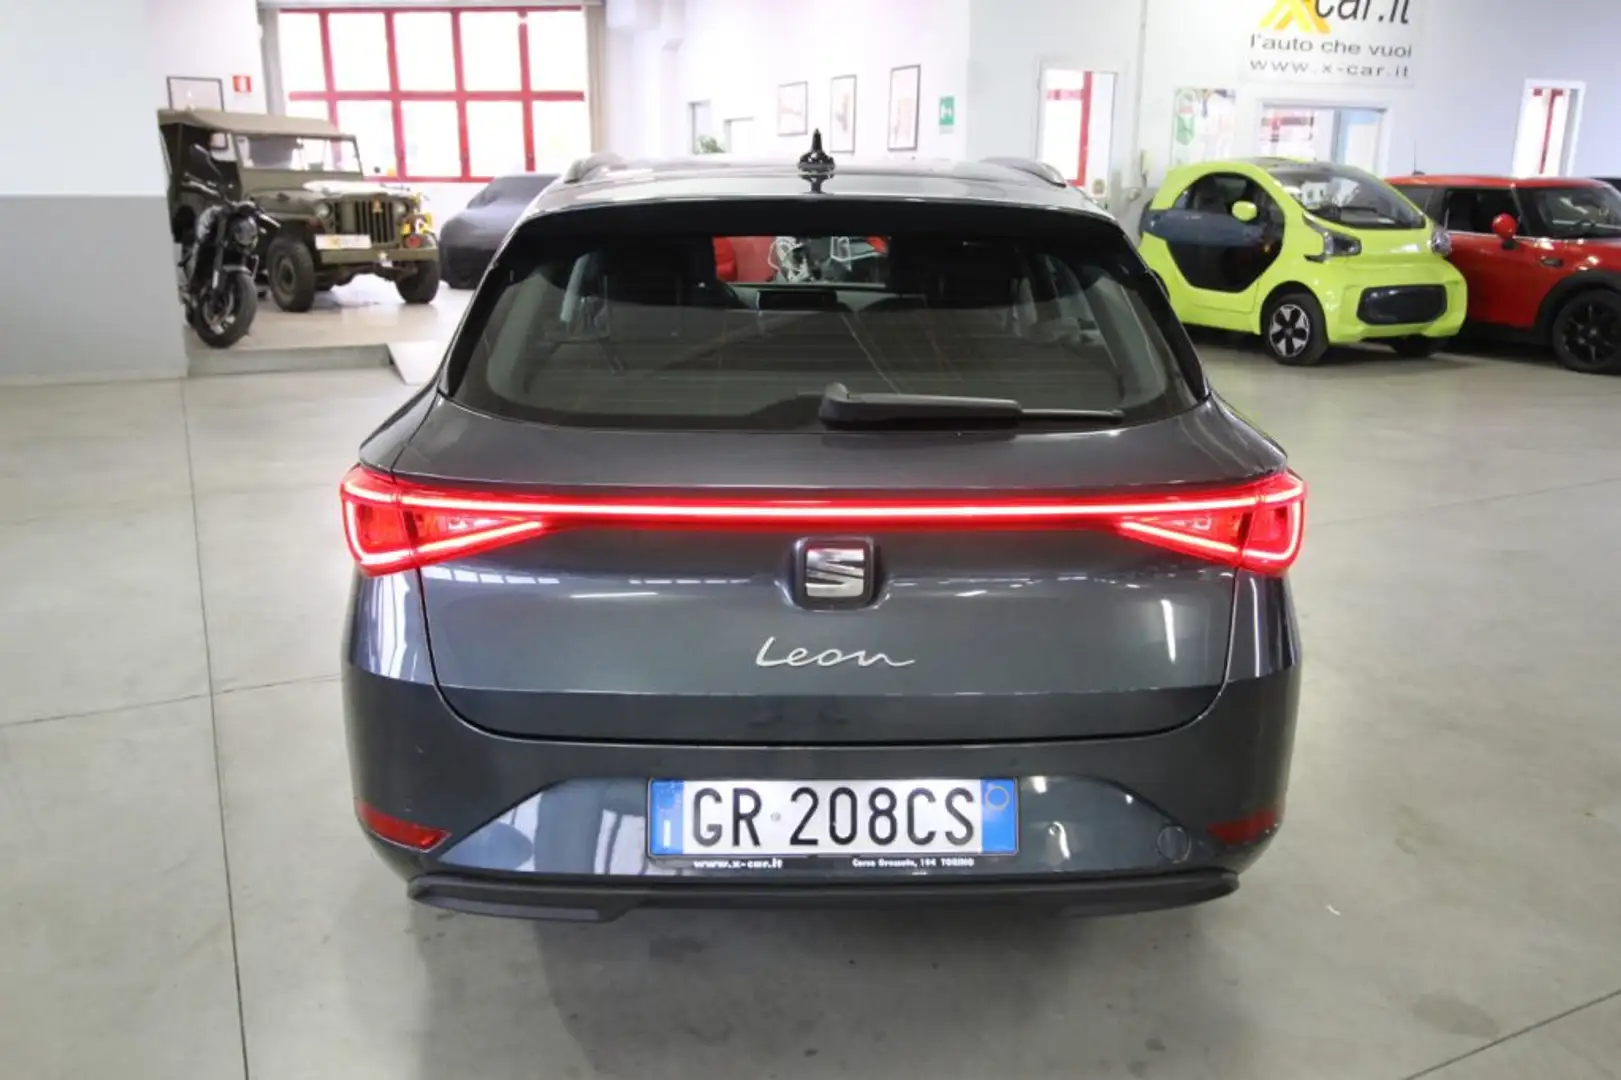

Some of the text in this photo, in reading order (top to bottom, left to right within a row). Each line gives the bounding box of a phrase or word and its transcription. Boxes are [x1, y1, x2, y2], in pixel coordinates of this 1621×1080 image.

[1321, 40, 1361, 55] che
[1368, 45, 1412, 58] vuoi
[1250, 59, 1409, 78] www.x-car.it
[756, 636, 916, 667] Leon
[693, 787, 762, 847] GR
